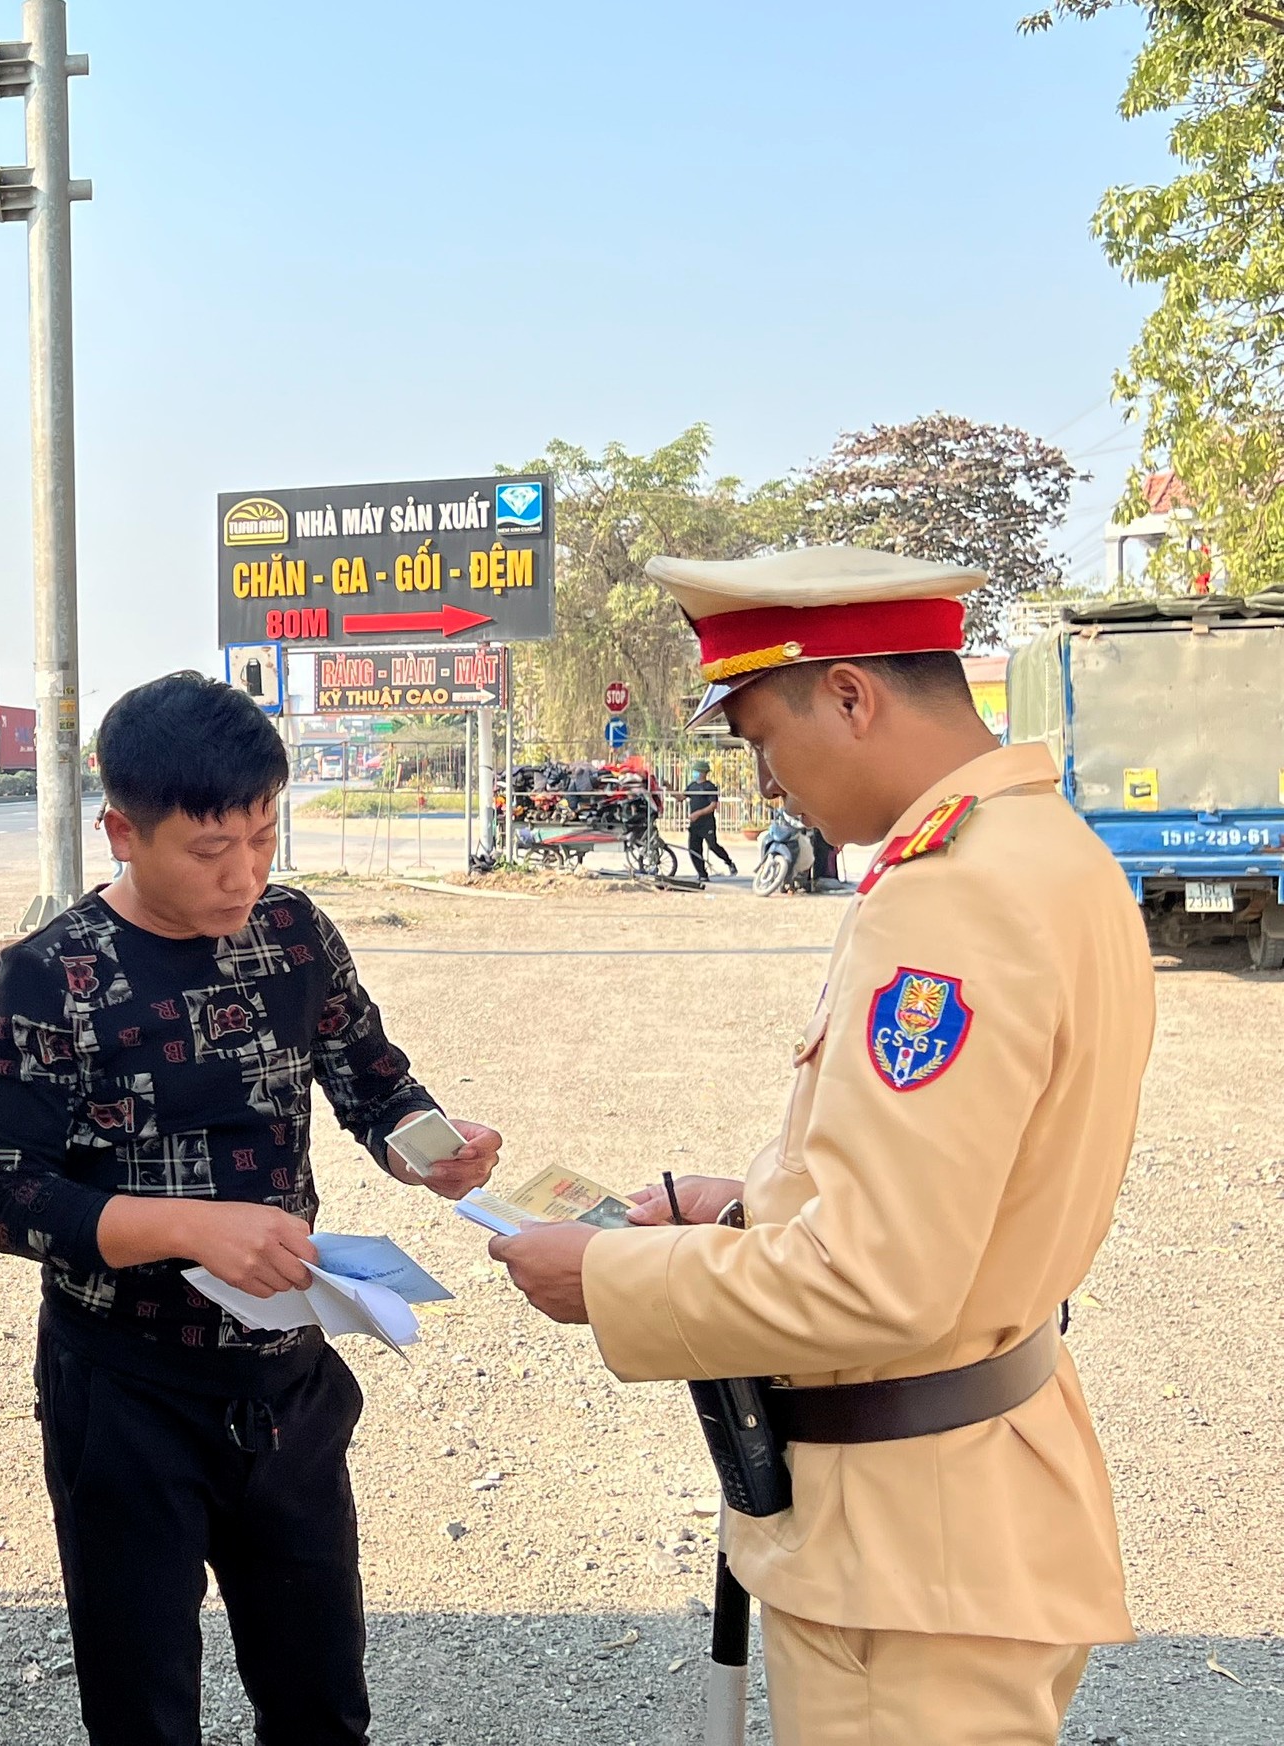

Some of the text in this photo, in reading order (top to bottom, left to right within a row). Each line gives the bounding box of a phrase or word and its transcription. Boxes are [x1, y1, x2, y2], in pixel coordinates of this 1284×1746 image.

[296, 491, 491, 538] NHÀ MÁY SẢN XUẤT
[232, 553, 306, 599] CHĂN
[331, 557, 369, 595] GA
[394, 538, 442, 592] GỐI
[469, 541, 534, 595] ĐỆM
[266, 608, 329, 639] 80M
[321, 653, 375, 688] RĂNG
[391, 652, 437, 686] HÀM
[319, 688, 342, 707] KỸ
[346, 686, 403, 709] THUẬT
[405, 688, 449, 705] CAO
[606, 690, 626, 704] STOP
[877, 1027, 948, 1056] CSGT
